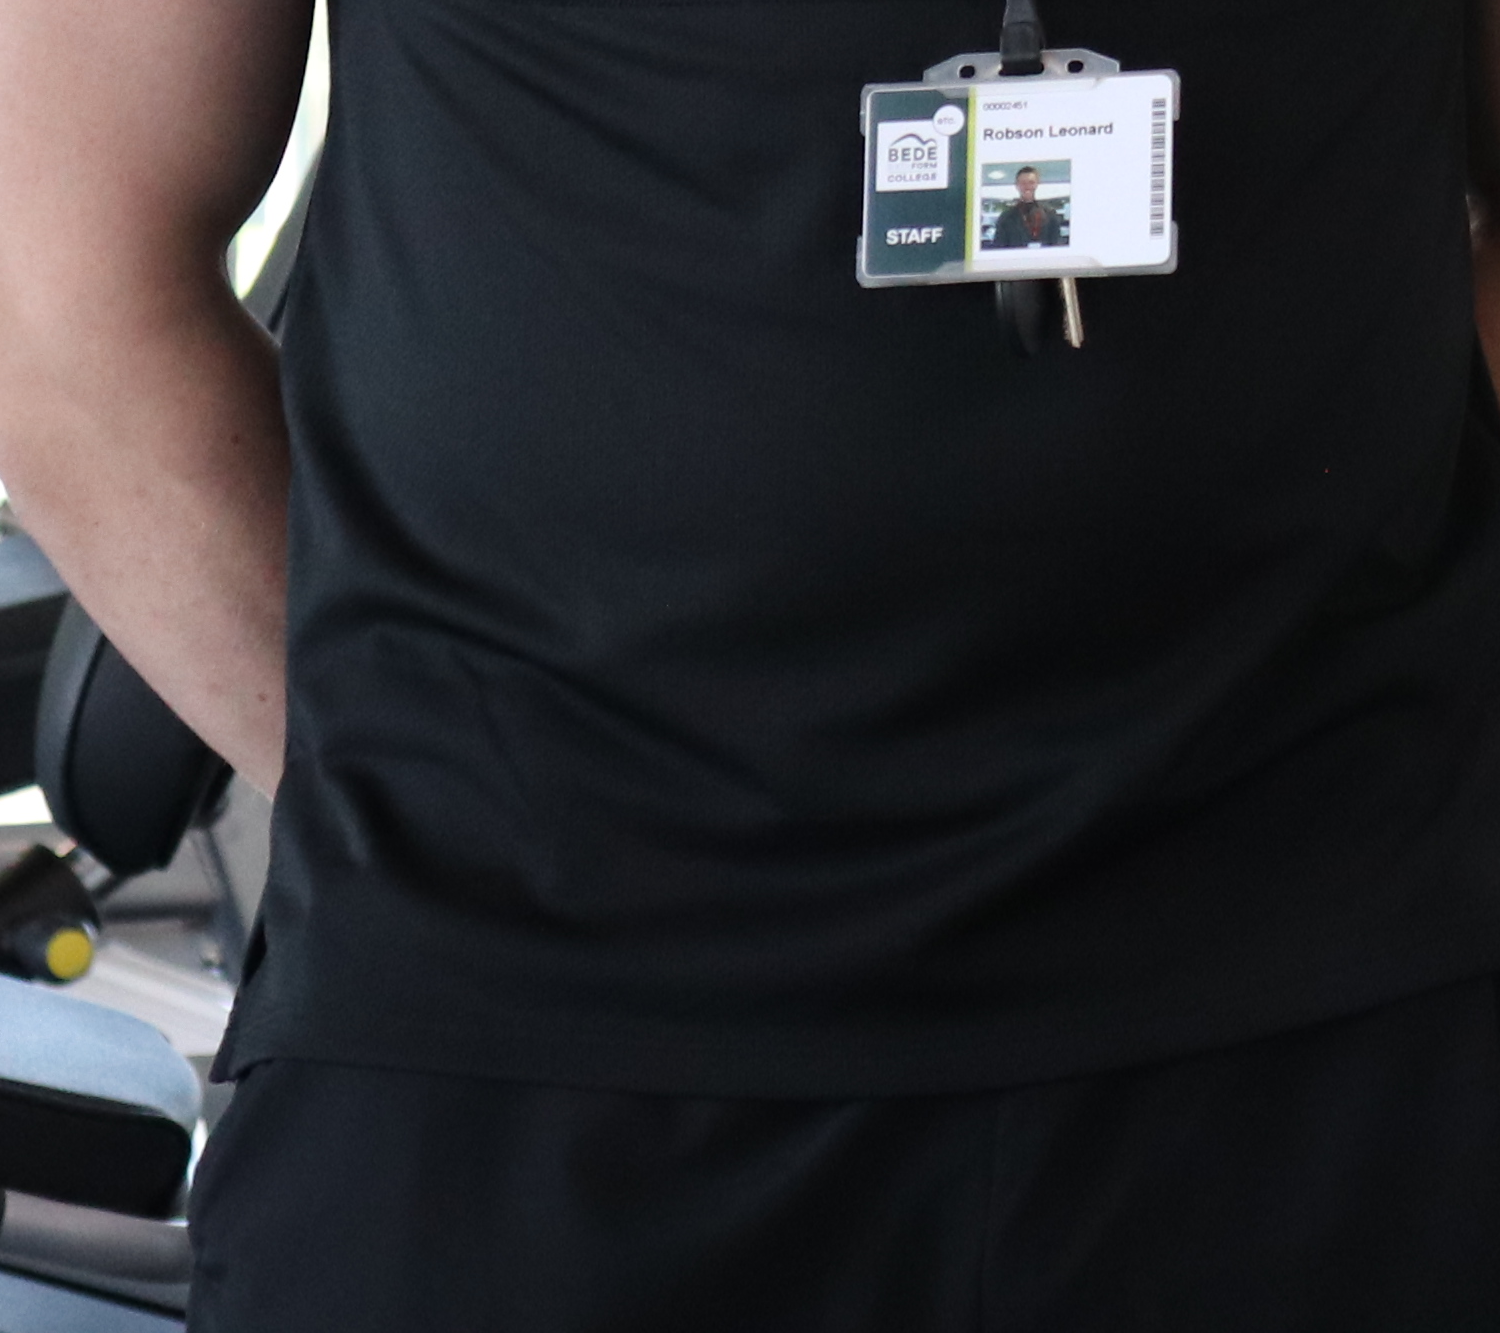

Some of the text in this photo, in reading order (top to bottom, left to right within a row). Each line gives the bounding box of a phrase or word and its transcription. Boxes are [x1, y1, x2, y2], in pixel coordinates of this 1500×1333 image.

[983, 122, 1113, 141] Robson Leonard
[888, 146, 938, 162] BEDE
[887, 172, 937, 183] COLLEGE
[886, 227, 943, 245] STAFF
